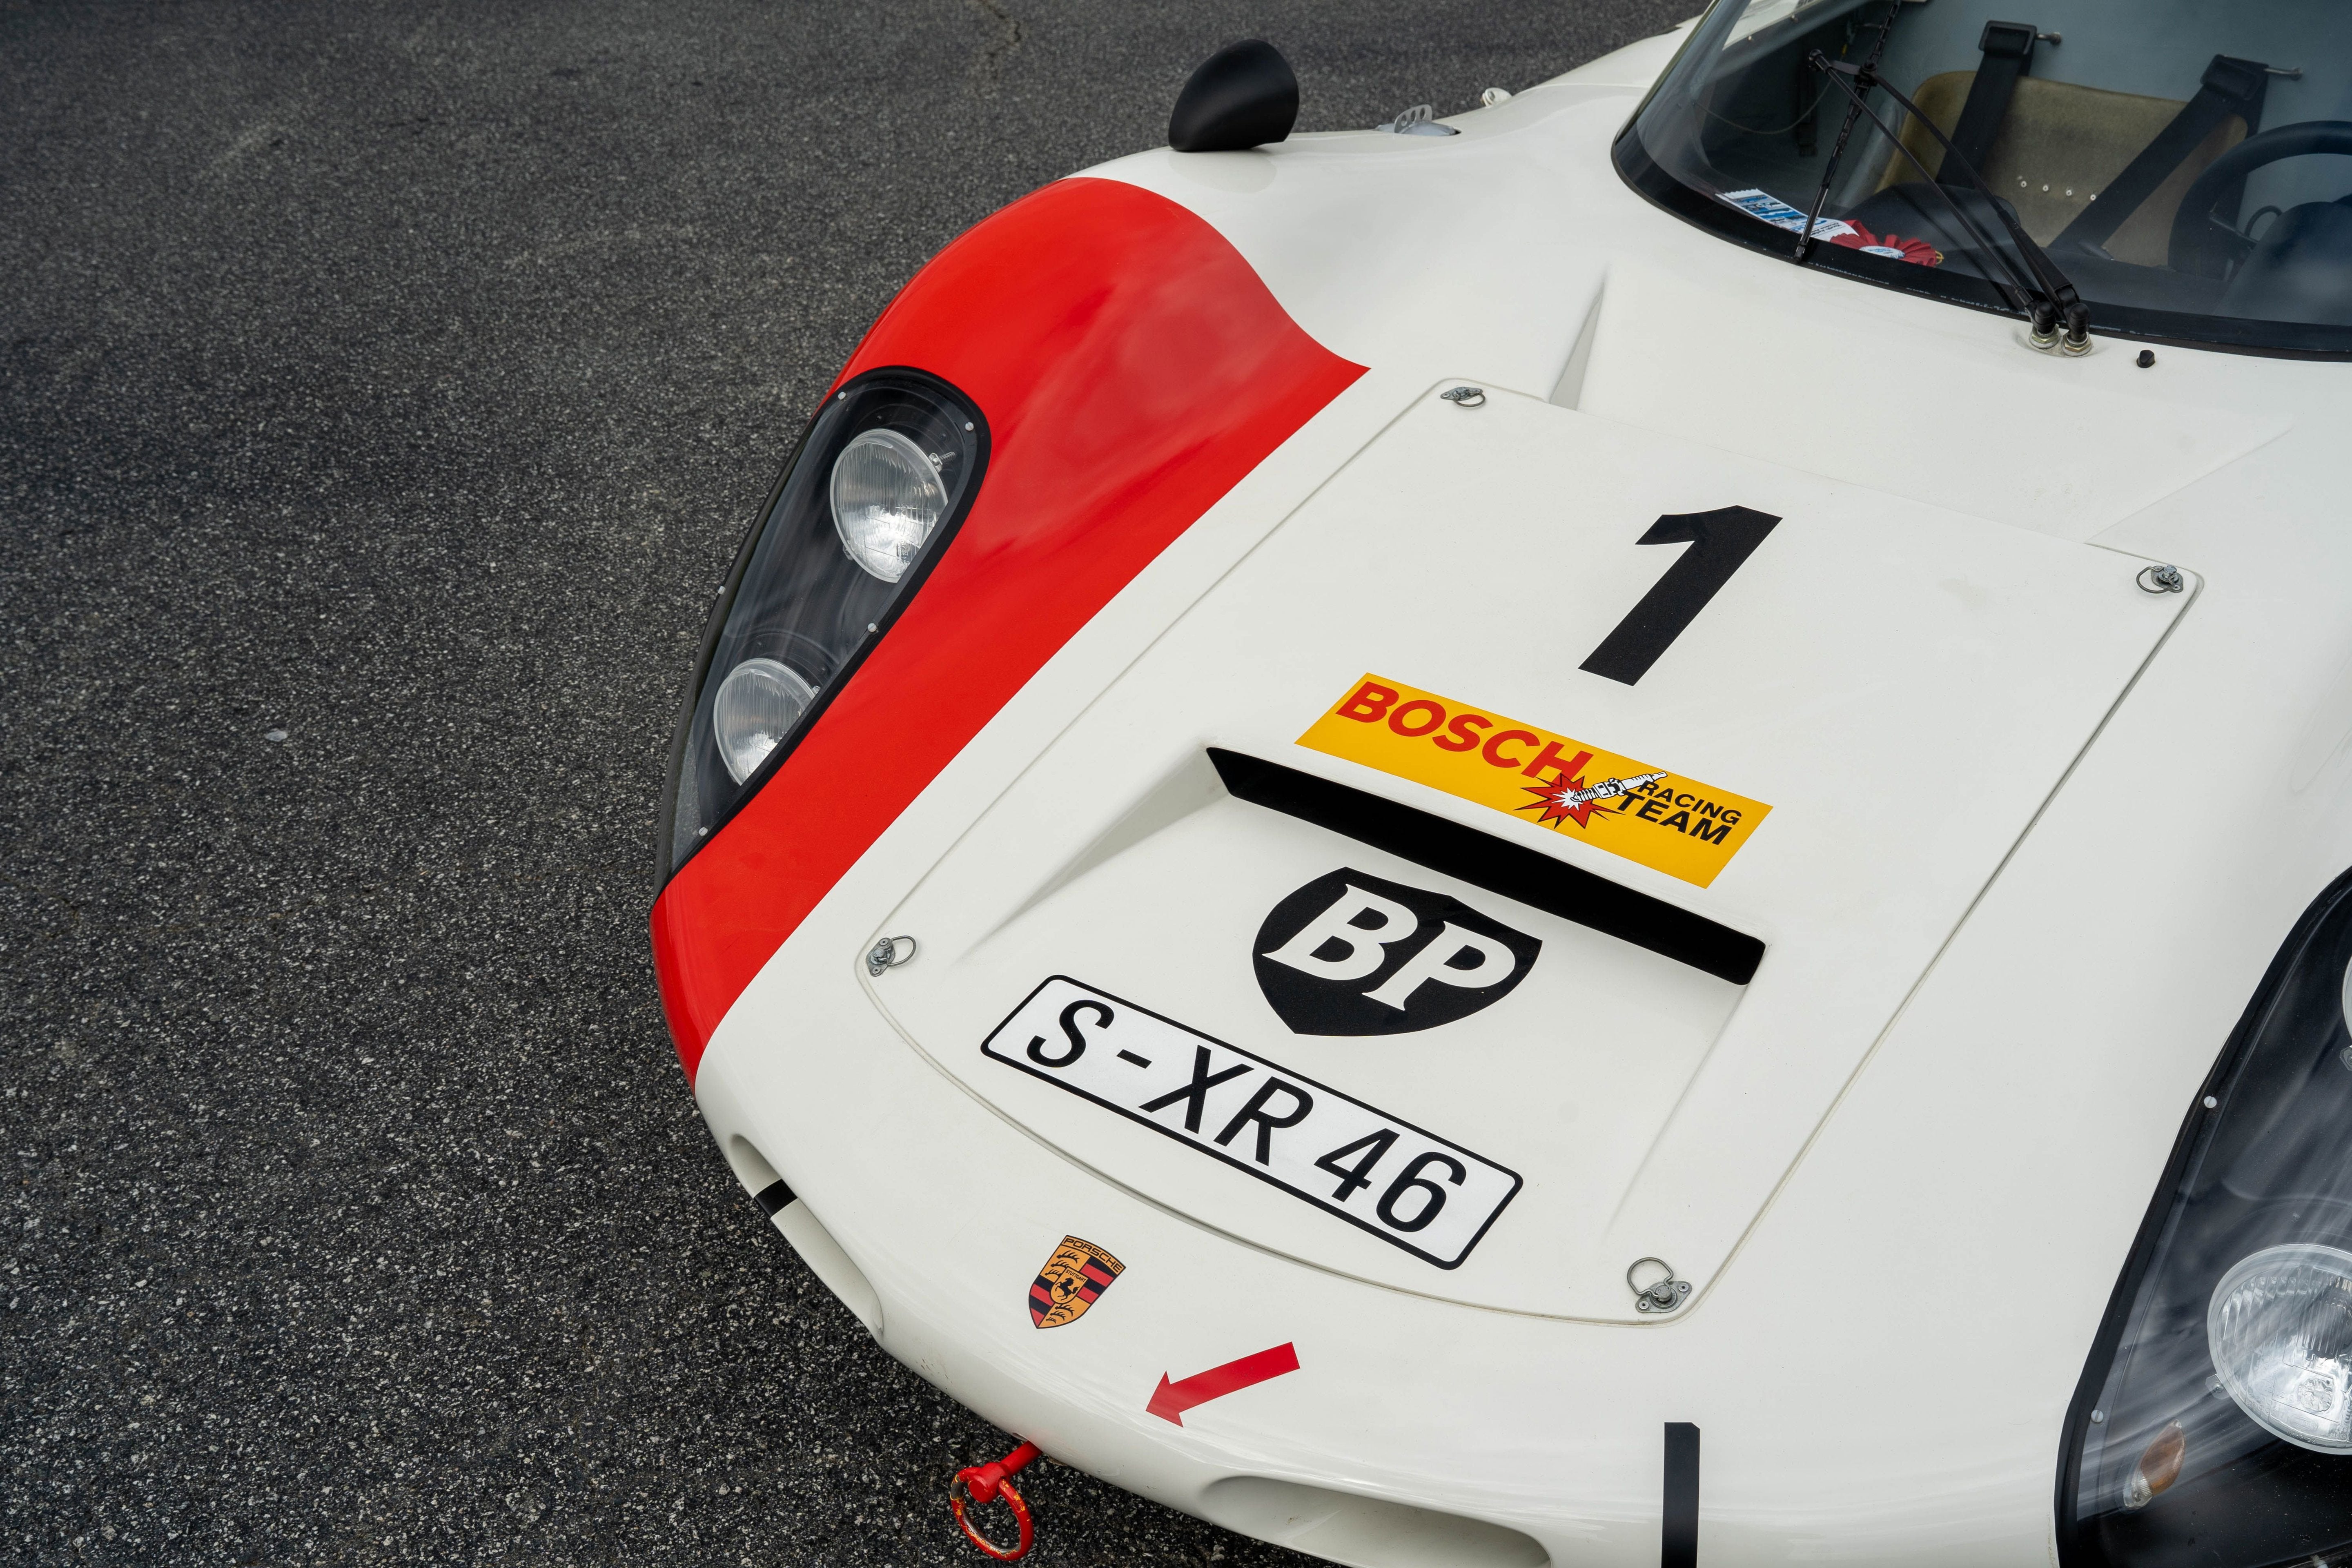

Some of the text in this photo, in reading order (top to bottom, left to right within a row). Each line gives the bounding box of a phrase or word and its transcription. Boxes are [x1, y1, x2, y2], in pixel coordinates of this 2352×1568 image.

[1578, 506, 1782, 686] 1
[1336, 682, 1594, 780] BOSCH
[1617, 791, 1732, 845] TEAM
[1637, 780, 1742, 825] RACING
[1262, 884, 1515, 1011] BP
[1027, 1000, 1466, 1232] S-XR 46
[1063, 1238, 1123, 1272] PORSCHE
[1065, 1269, 1087, 1283] STUTTGART
